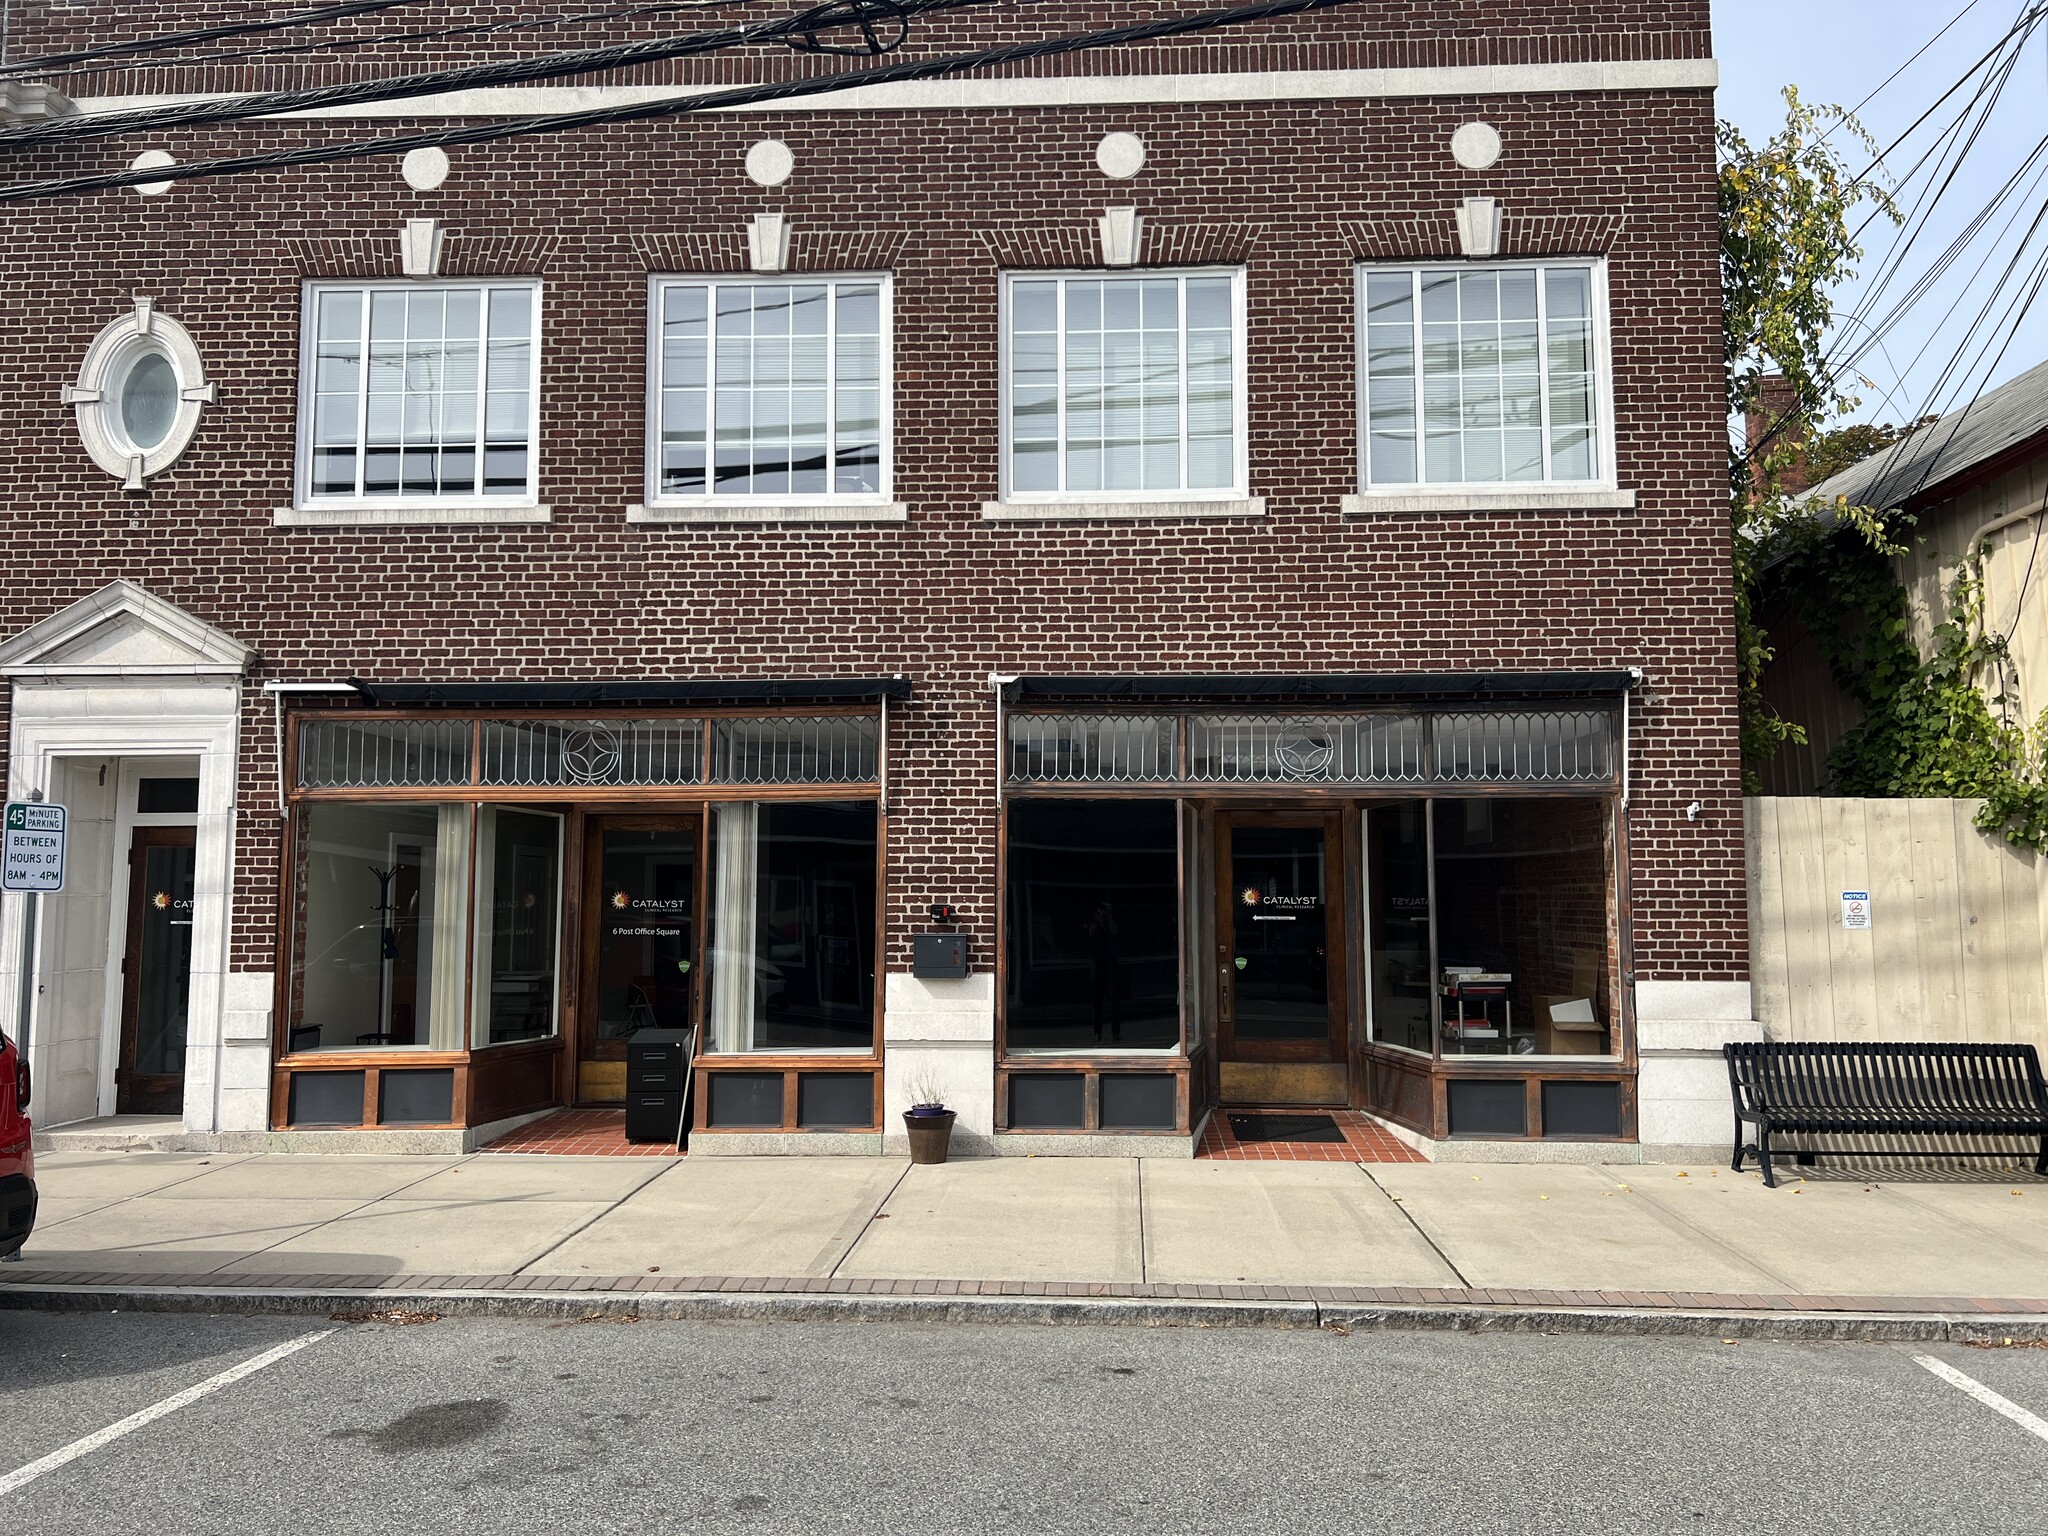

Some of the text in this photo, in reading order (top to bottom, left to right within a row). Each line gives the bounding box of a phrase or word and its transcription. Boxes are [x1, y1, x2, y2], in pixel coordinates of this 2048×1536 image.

[9, 809, 24, 825] 45
[29, 809, 59, 819] MINUTE
[27, 819, 60, 829] PARKING
[13, 836, 57, 847] BETWEEN
[9, 853, 59, 864] HOURS OF
[7, 869, 27, 880] 8AM
[39, 871, 59, 881] 4PM
[173, 900, 195, 909] CAT
[632, 899, 685, 908] CATALYST
[1263, 896, 1317, 905] CATALYST
[612, 927, 681, 937] 6 Post Office Square
